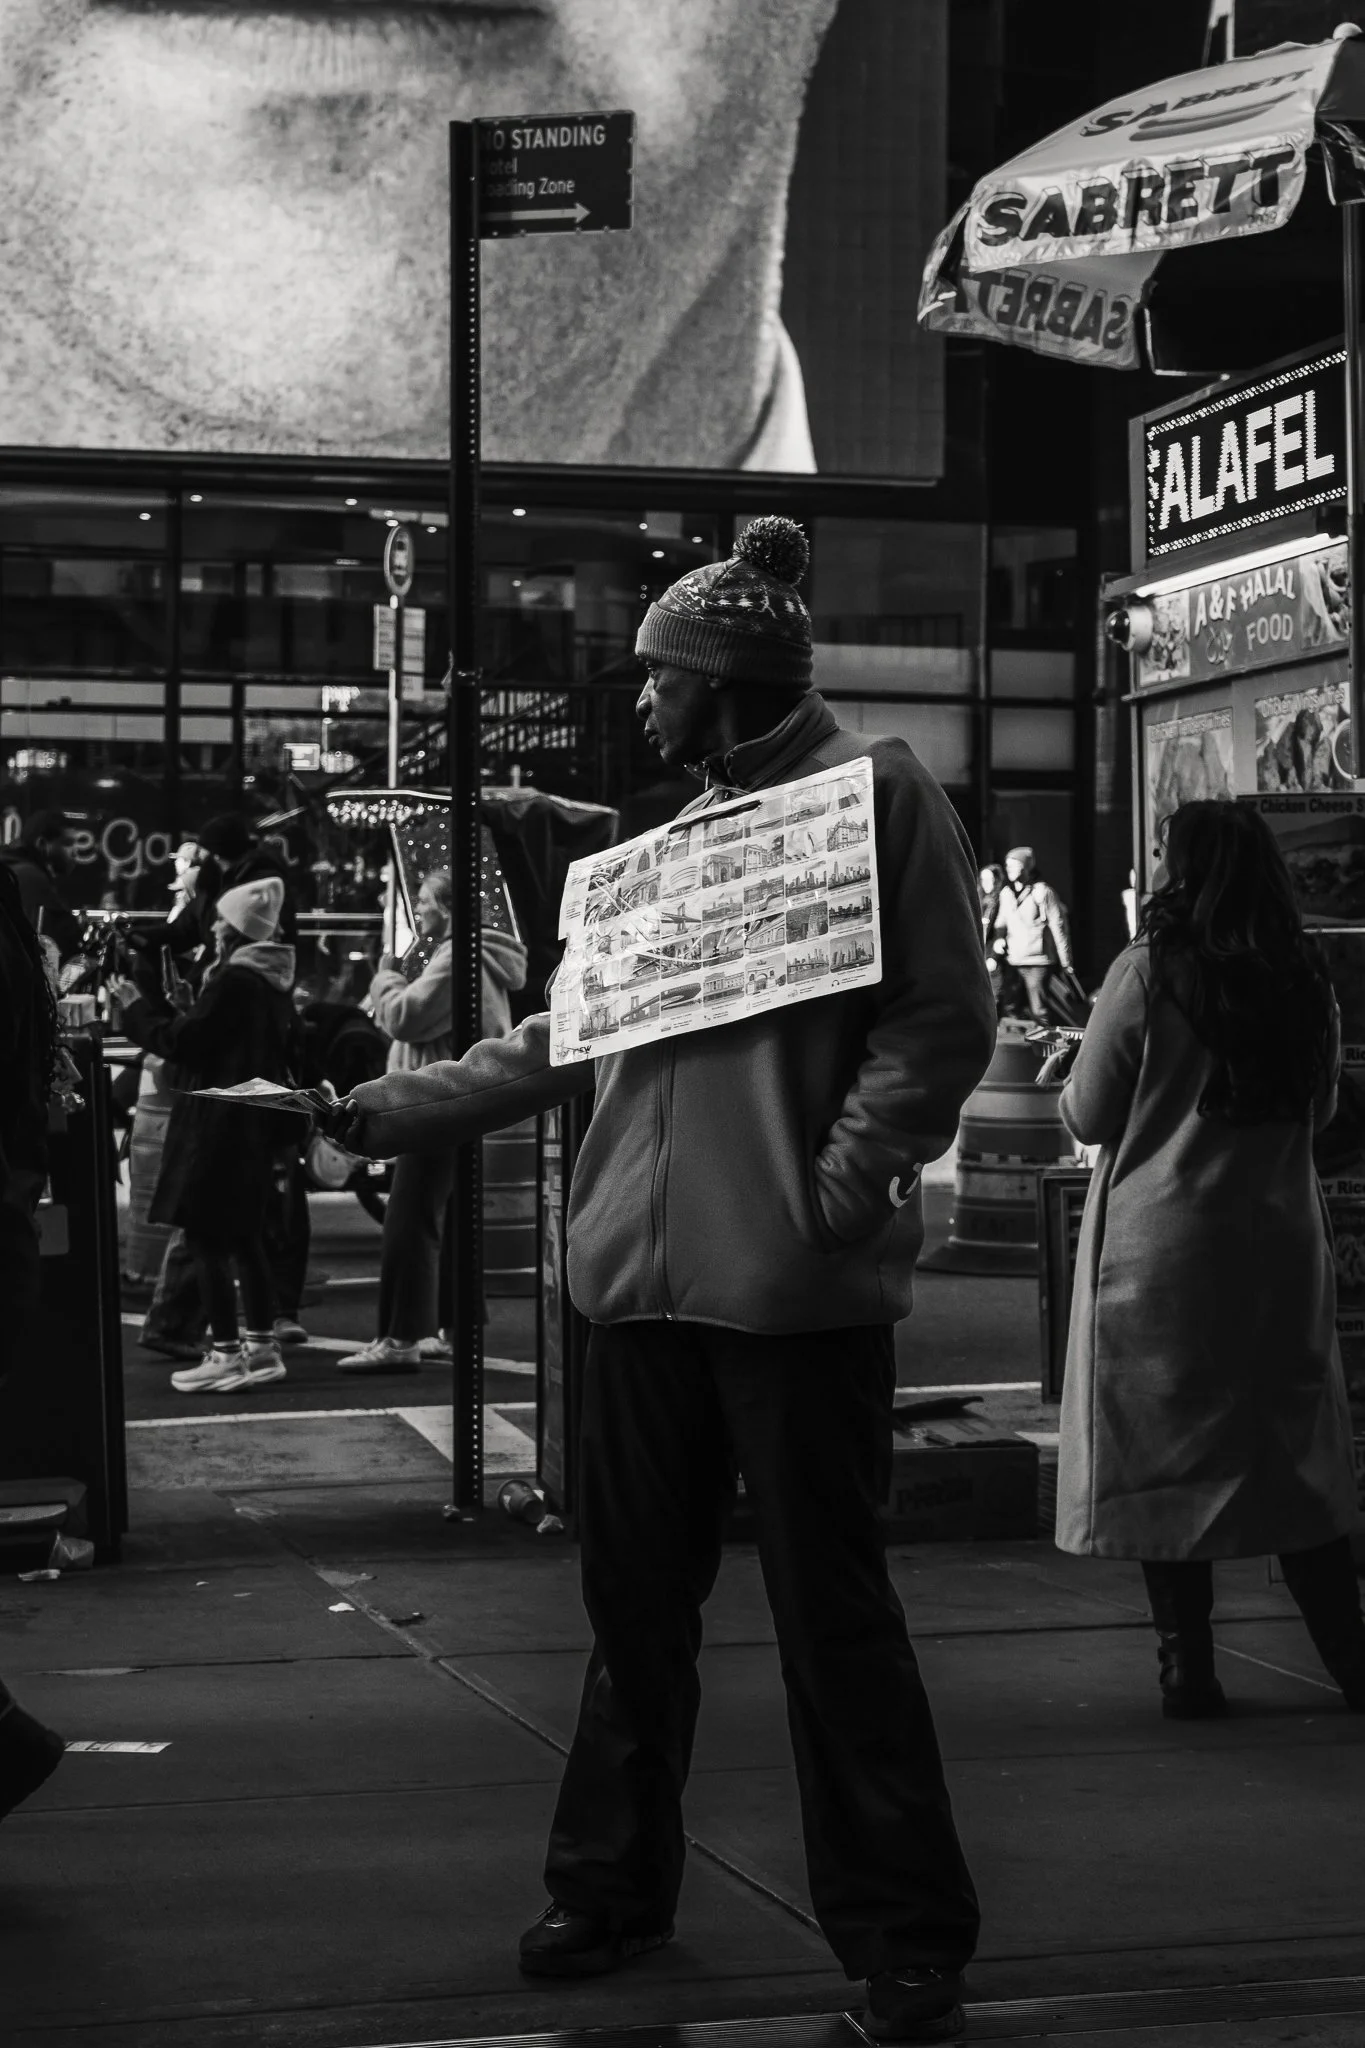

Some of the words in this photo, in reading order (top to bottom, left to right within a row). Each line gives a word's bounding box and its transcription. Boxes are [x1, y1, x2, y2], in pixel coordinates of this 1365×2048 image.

[510, 125, 607, 150] STANDING
[487, 157, 518, 176] otel
[486, 178, 536, 200] oading
[538, 177, 576, 195] Zone
[977, 144, 1297, 247] SABRETT
[1148, 389, 1335, 530] ALAFEL
[1239, 564, 1297, 613] HALAL
[1246, 612, 1294, 652] FOOD
[1261, 798, 1305, 813] Chicken
[1310, 797, 1353, 812] Cheese
[1337, 1180, 1365, 1195] Ric
